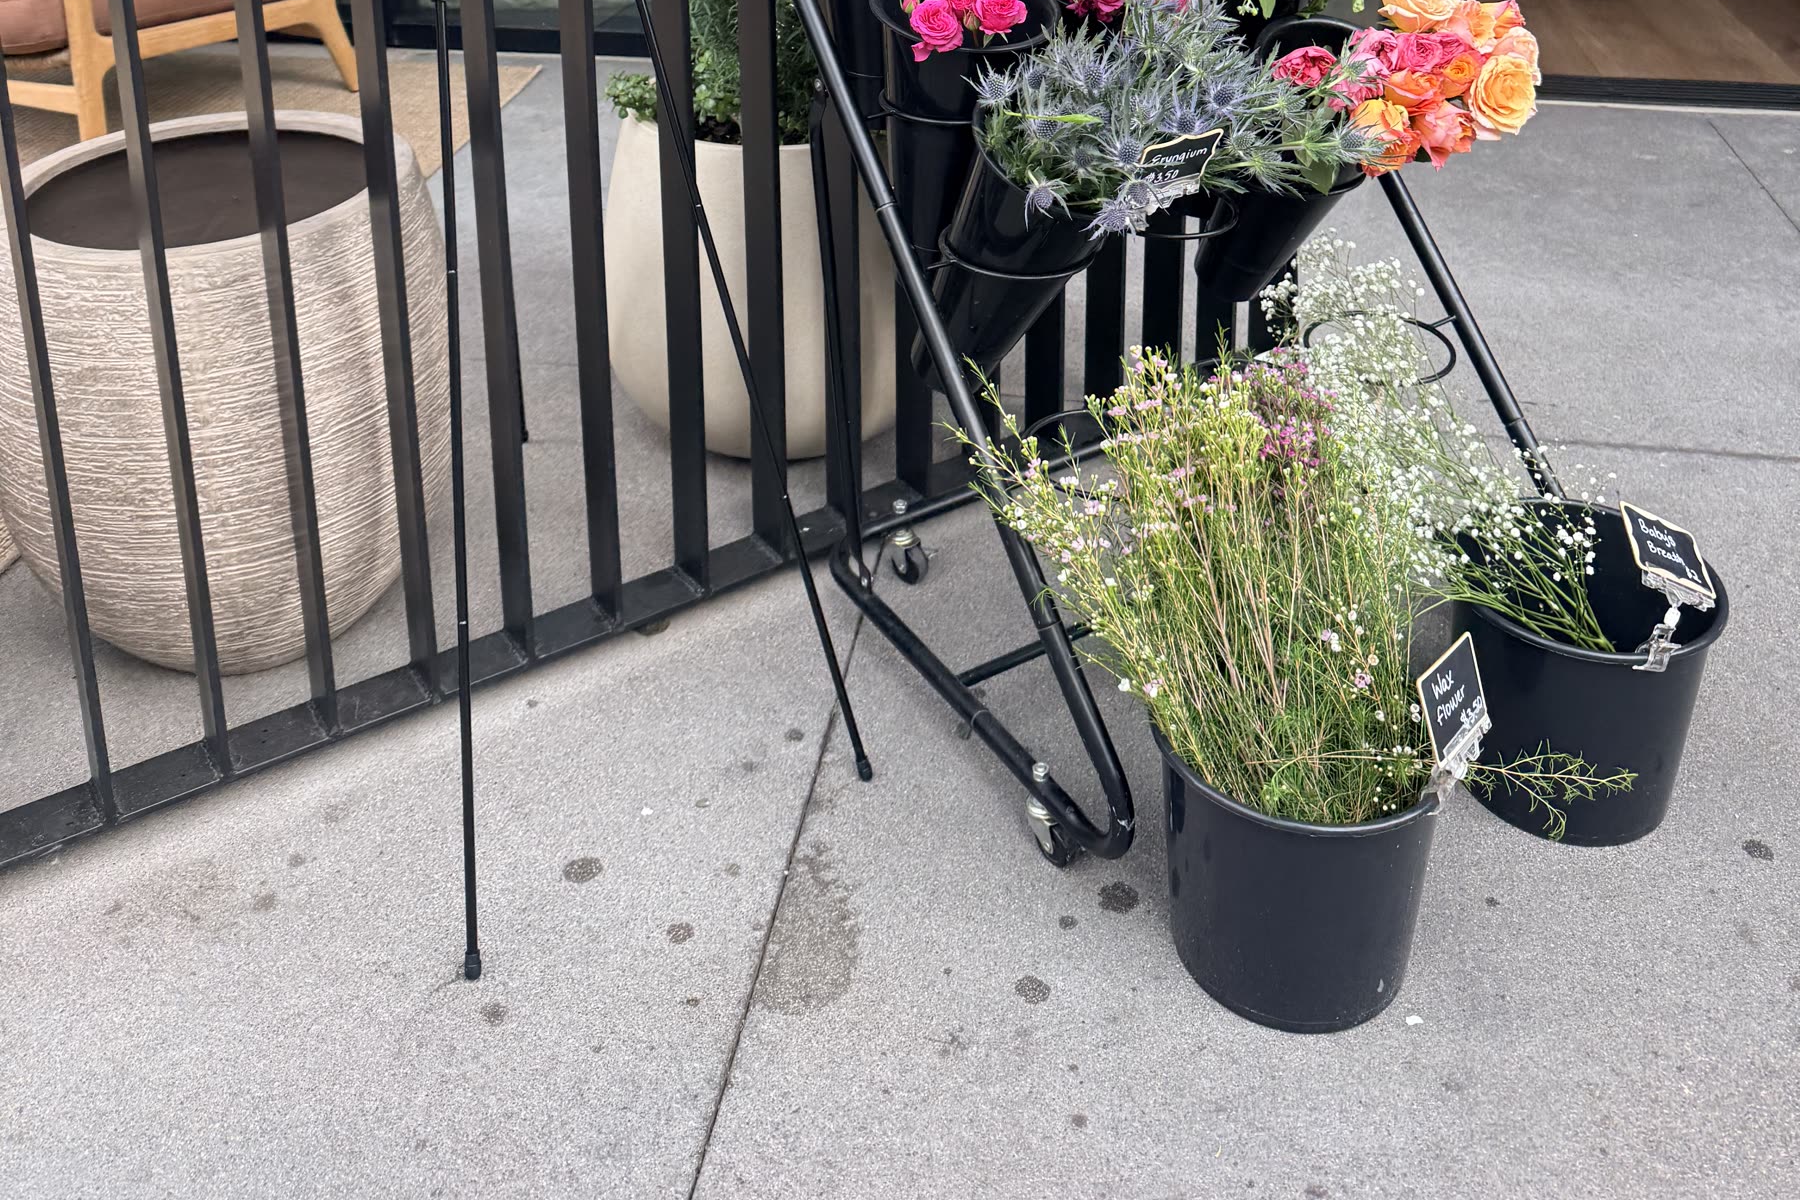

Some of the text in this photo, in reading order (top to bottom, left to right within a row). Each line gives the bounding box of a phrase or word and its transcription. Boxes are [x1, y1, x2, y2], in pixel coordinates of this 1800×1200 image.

[1151, 147, 1208, 169] Eryngium
[1637, 518, 1677, 548] Baby's
[1646, 540, 1686, 566] Breath
[1431, 669, 1455, 700] Wax
